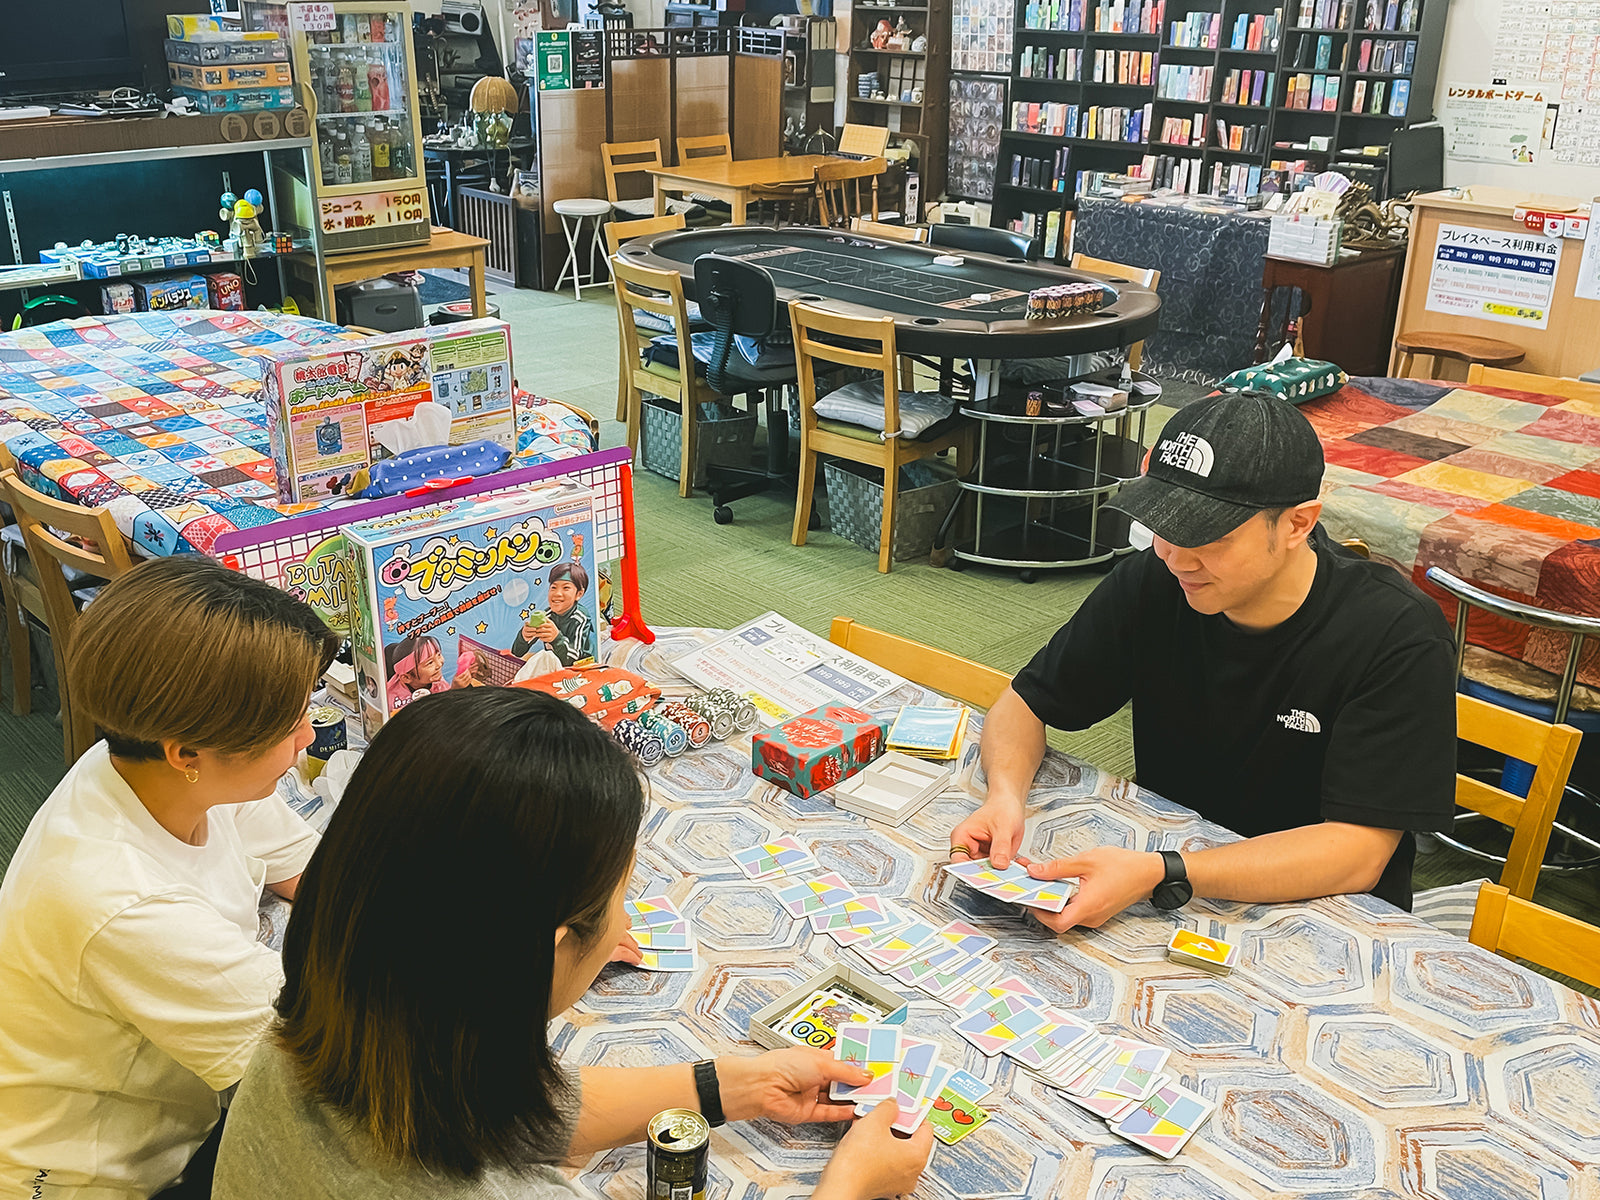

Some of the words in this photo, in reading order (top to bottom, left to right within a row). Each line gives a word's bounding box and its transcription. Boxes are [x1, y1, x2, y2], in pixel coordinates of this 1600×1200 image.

[1448, 87, 1543, 102] レンタルボードゲーム
[321, 200, 363, 214] ジュース
[385, 193, 421, 207] 150円
[387, 208, 423, 223] 110円
[1442, 229, 1558, 255] プレイスペース利用料金
[1436, 263, 1450, 271] 大人
[220, 279, 240, 294] UNO
[289, 382, 368, 405] ボードゲーム
[1176, 431, 1198, 446] THE
[1159, 439, 1194, 458] NORTH
[1159, 452, 1187, 469] FACE
[409, 532, 540, 592] ブタミントン
[1276, 714, 1306, 724] NORTH
[1290, 709, 1306, 717] THE
[1285, 721, 1306, 732] FACE
